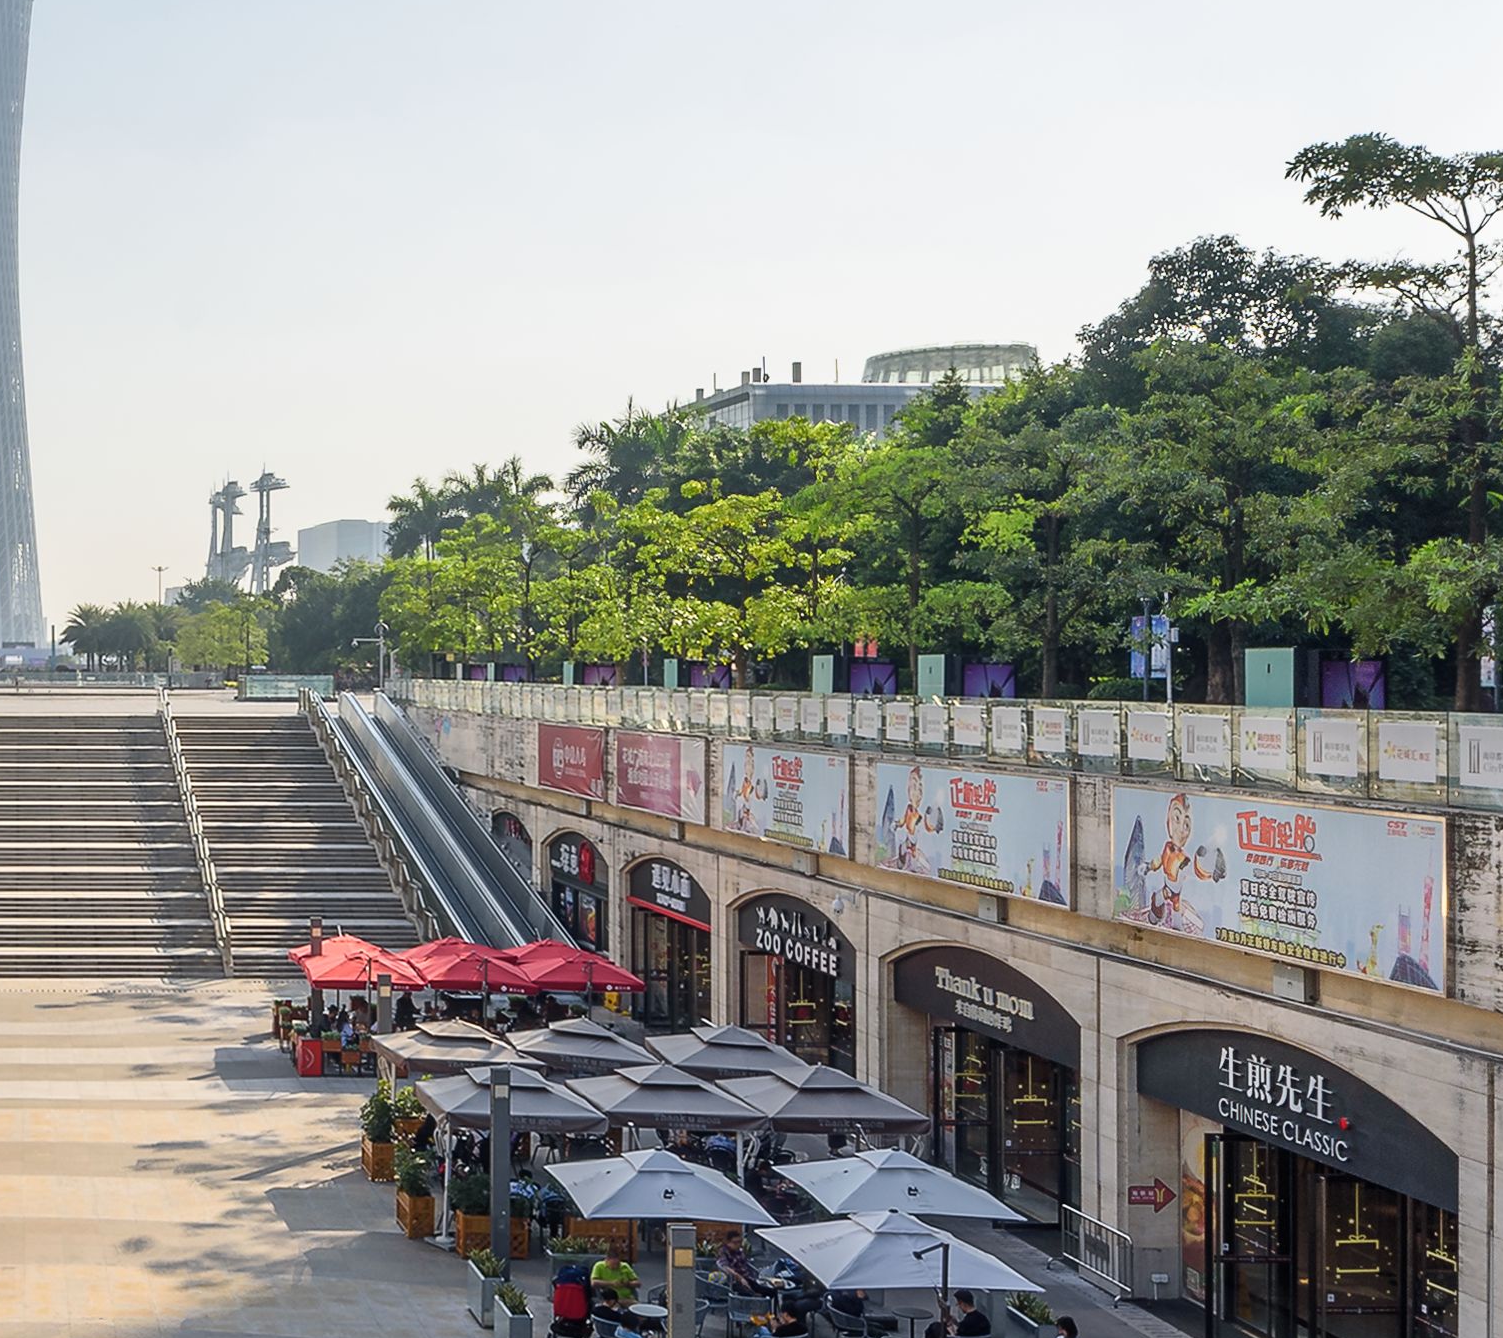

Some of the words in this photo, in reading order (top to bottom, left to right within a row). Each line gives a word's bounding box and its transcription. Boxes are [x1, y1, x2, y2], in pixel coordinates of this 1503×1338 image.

[1236, 811, 1323, 861] 正新轮胎
[1387, 820, 1408, 831] CST
[652, 863, 692, 899] 遇见小面
[756, 928, 781, 954] ZOO
[785, 937, 837, 977] COFFEE
[935, 966, 981, 1001] Thank
[984, 987, 994, 1004] u
[996, 992, 1035, 1021] mom
[1218, 1046, 1335, 1125] 生煎先生
[1218, 1098, 1278, 1136] CHINESE
[1282, 1120, 1349, 1162] CLASSIC
